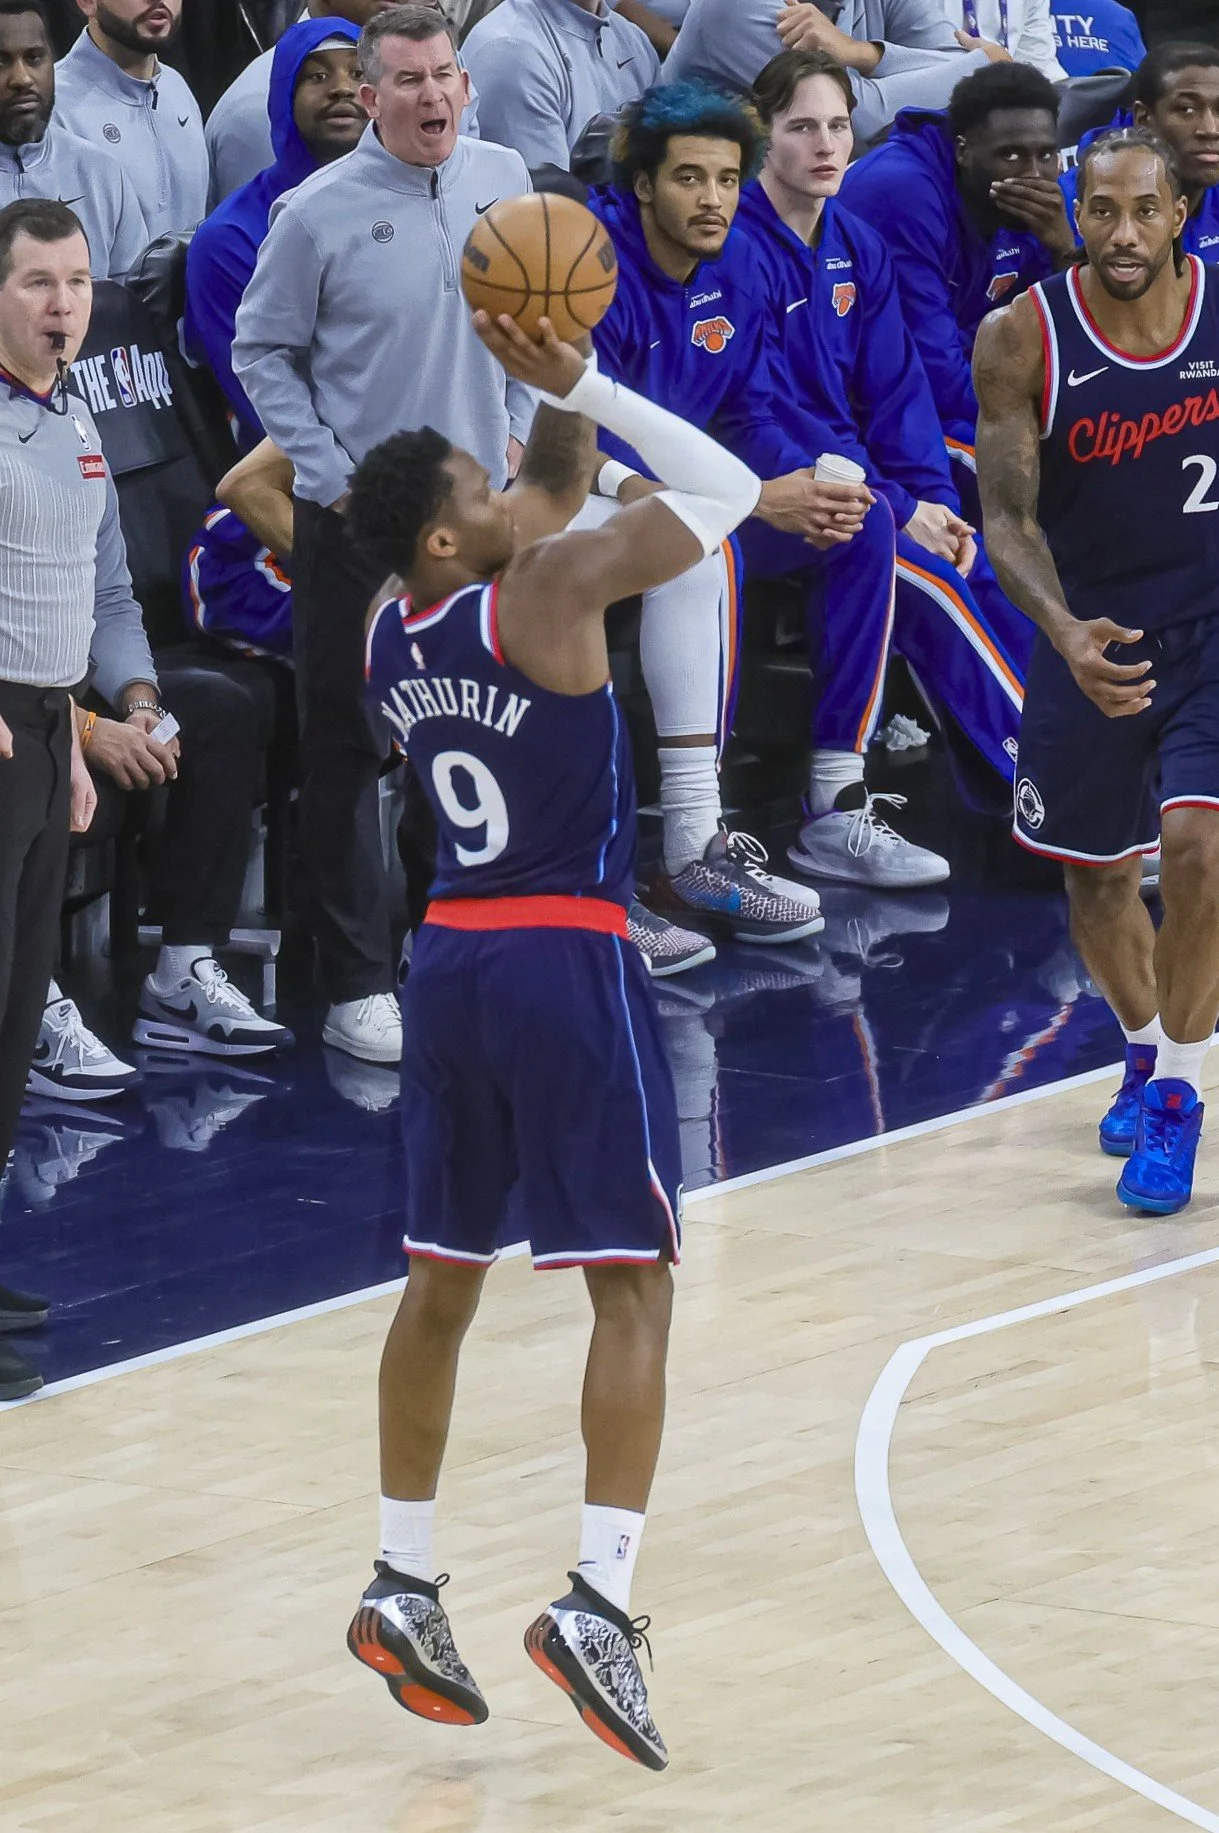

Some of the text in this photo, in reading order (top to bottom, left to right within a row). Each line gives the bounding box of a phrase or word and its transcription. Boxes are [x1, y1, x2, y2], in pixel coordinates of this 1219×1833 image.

[1067, 35, 1109, 53] HERE
[70, 355, 117, 414] THE
[1188, 360, 1214, 370] VISIT
[1182, 454, 1219, 514] 2
[432, 751, 510, 867] 9
